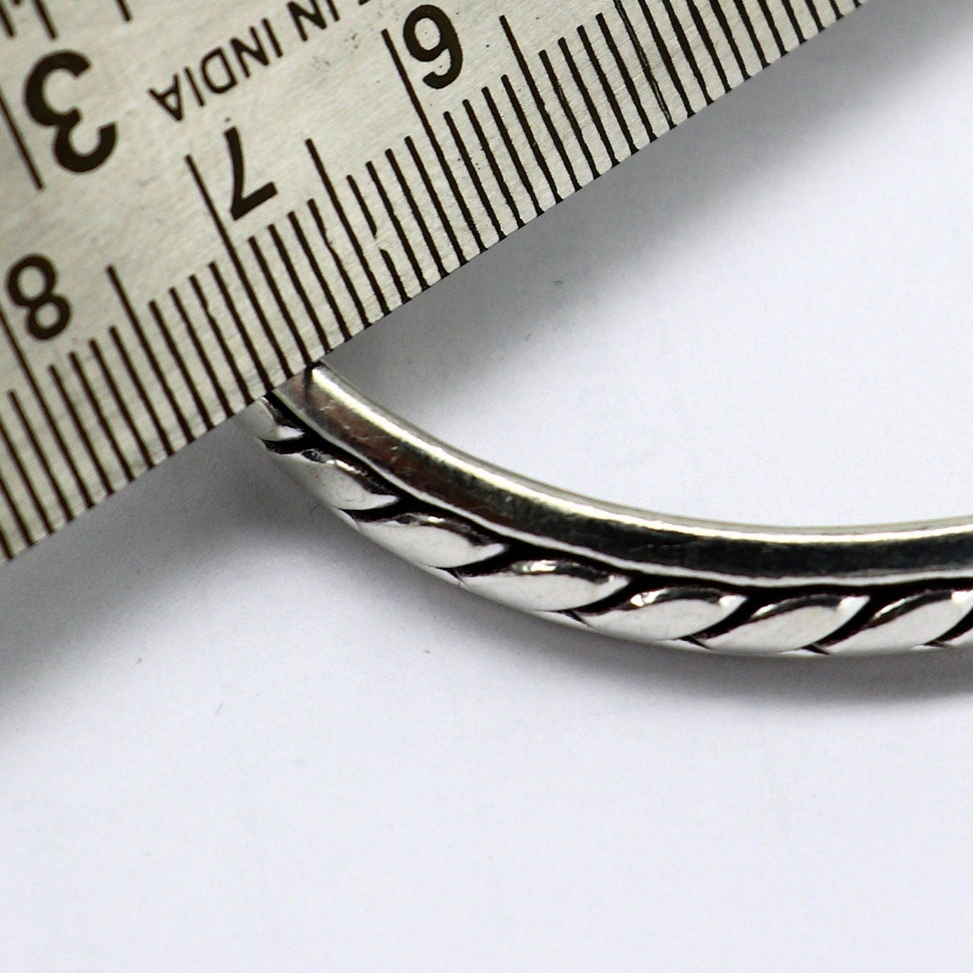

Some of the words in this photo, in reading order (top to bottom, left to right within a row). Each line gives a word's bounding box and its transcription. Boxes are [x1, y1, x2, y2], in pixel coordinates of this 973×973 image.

[148, 18, 284, 122] INDIA
[403, 4, 463, 90] 6
[24, 50, 117, 174] 3
[223, 126, 278, 221] 7
[6, 254, 71, 341] 8
